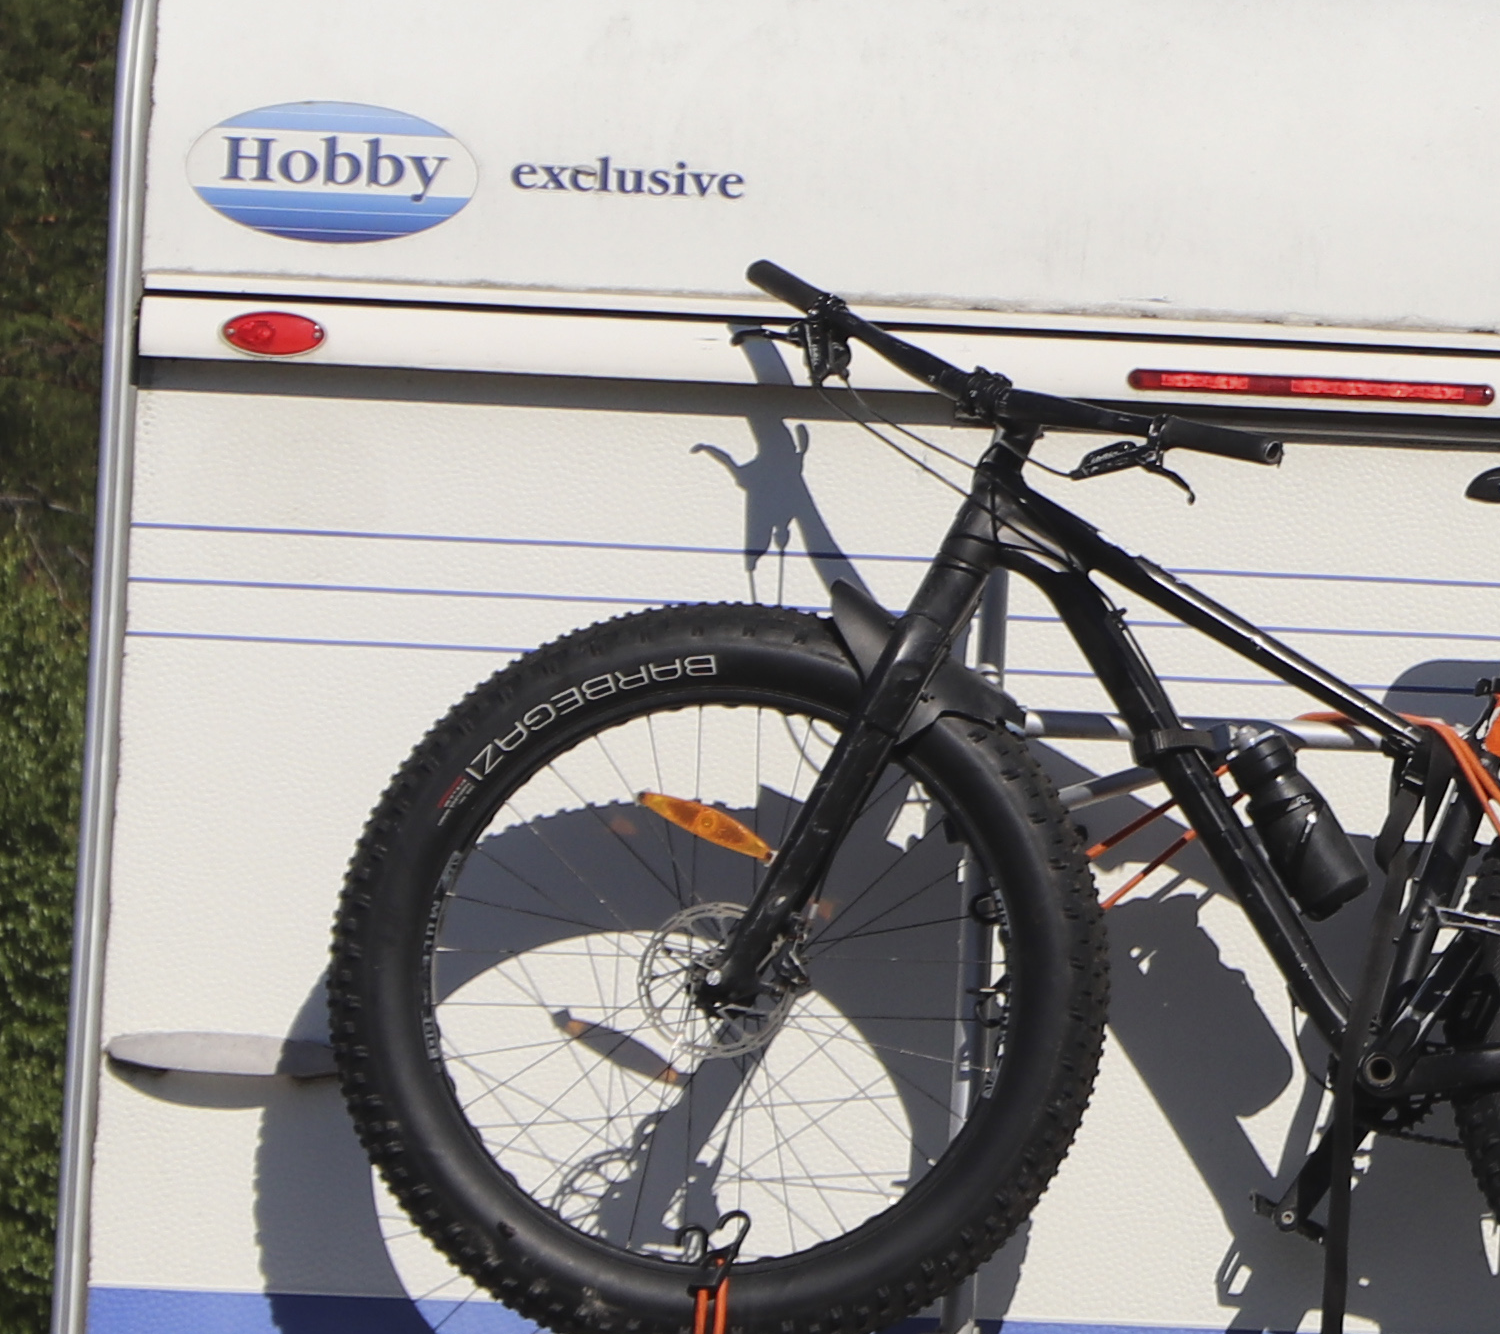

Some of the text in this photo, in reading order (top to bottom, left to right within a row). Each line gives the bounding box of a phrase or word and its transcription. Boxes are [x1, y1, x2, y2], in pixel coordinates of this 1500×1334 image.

[221, 135, 745, 204] Hobby exclusive
[465, 654, 717, 781] BARBEGAZI
